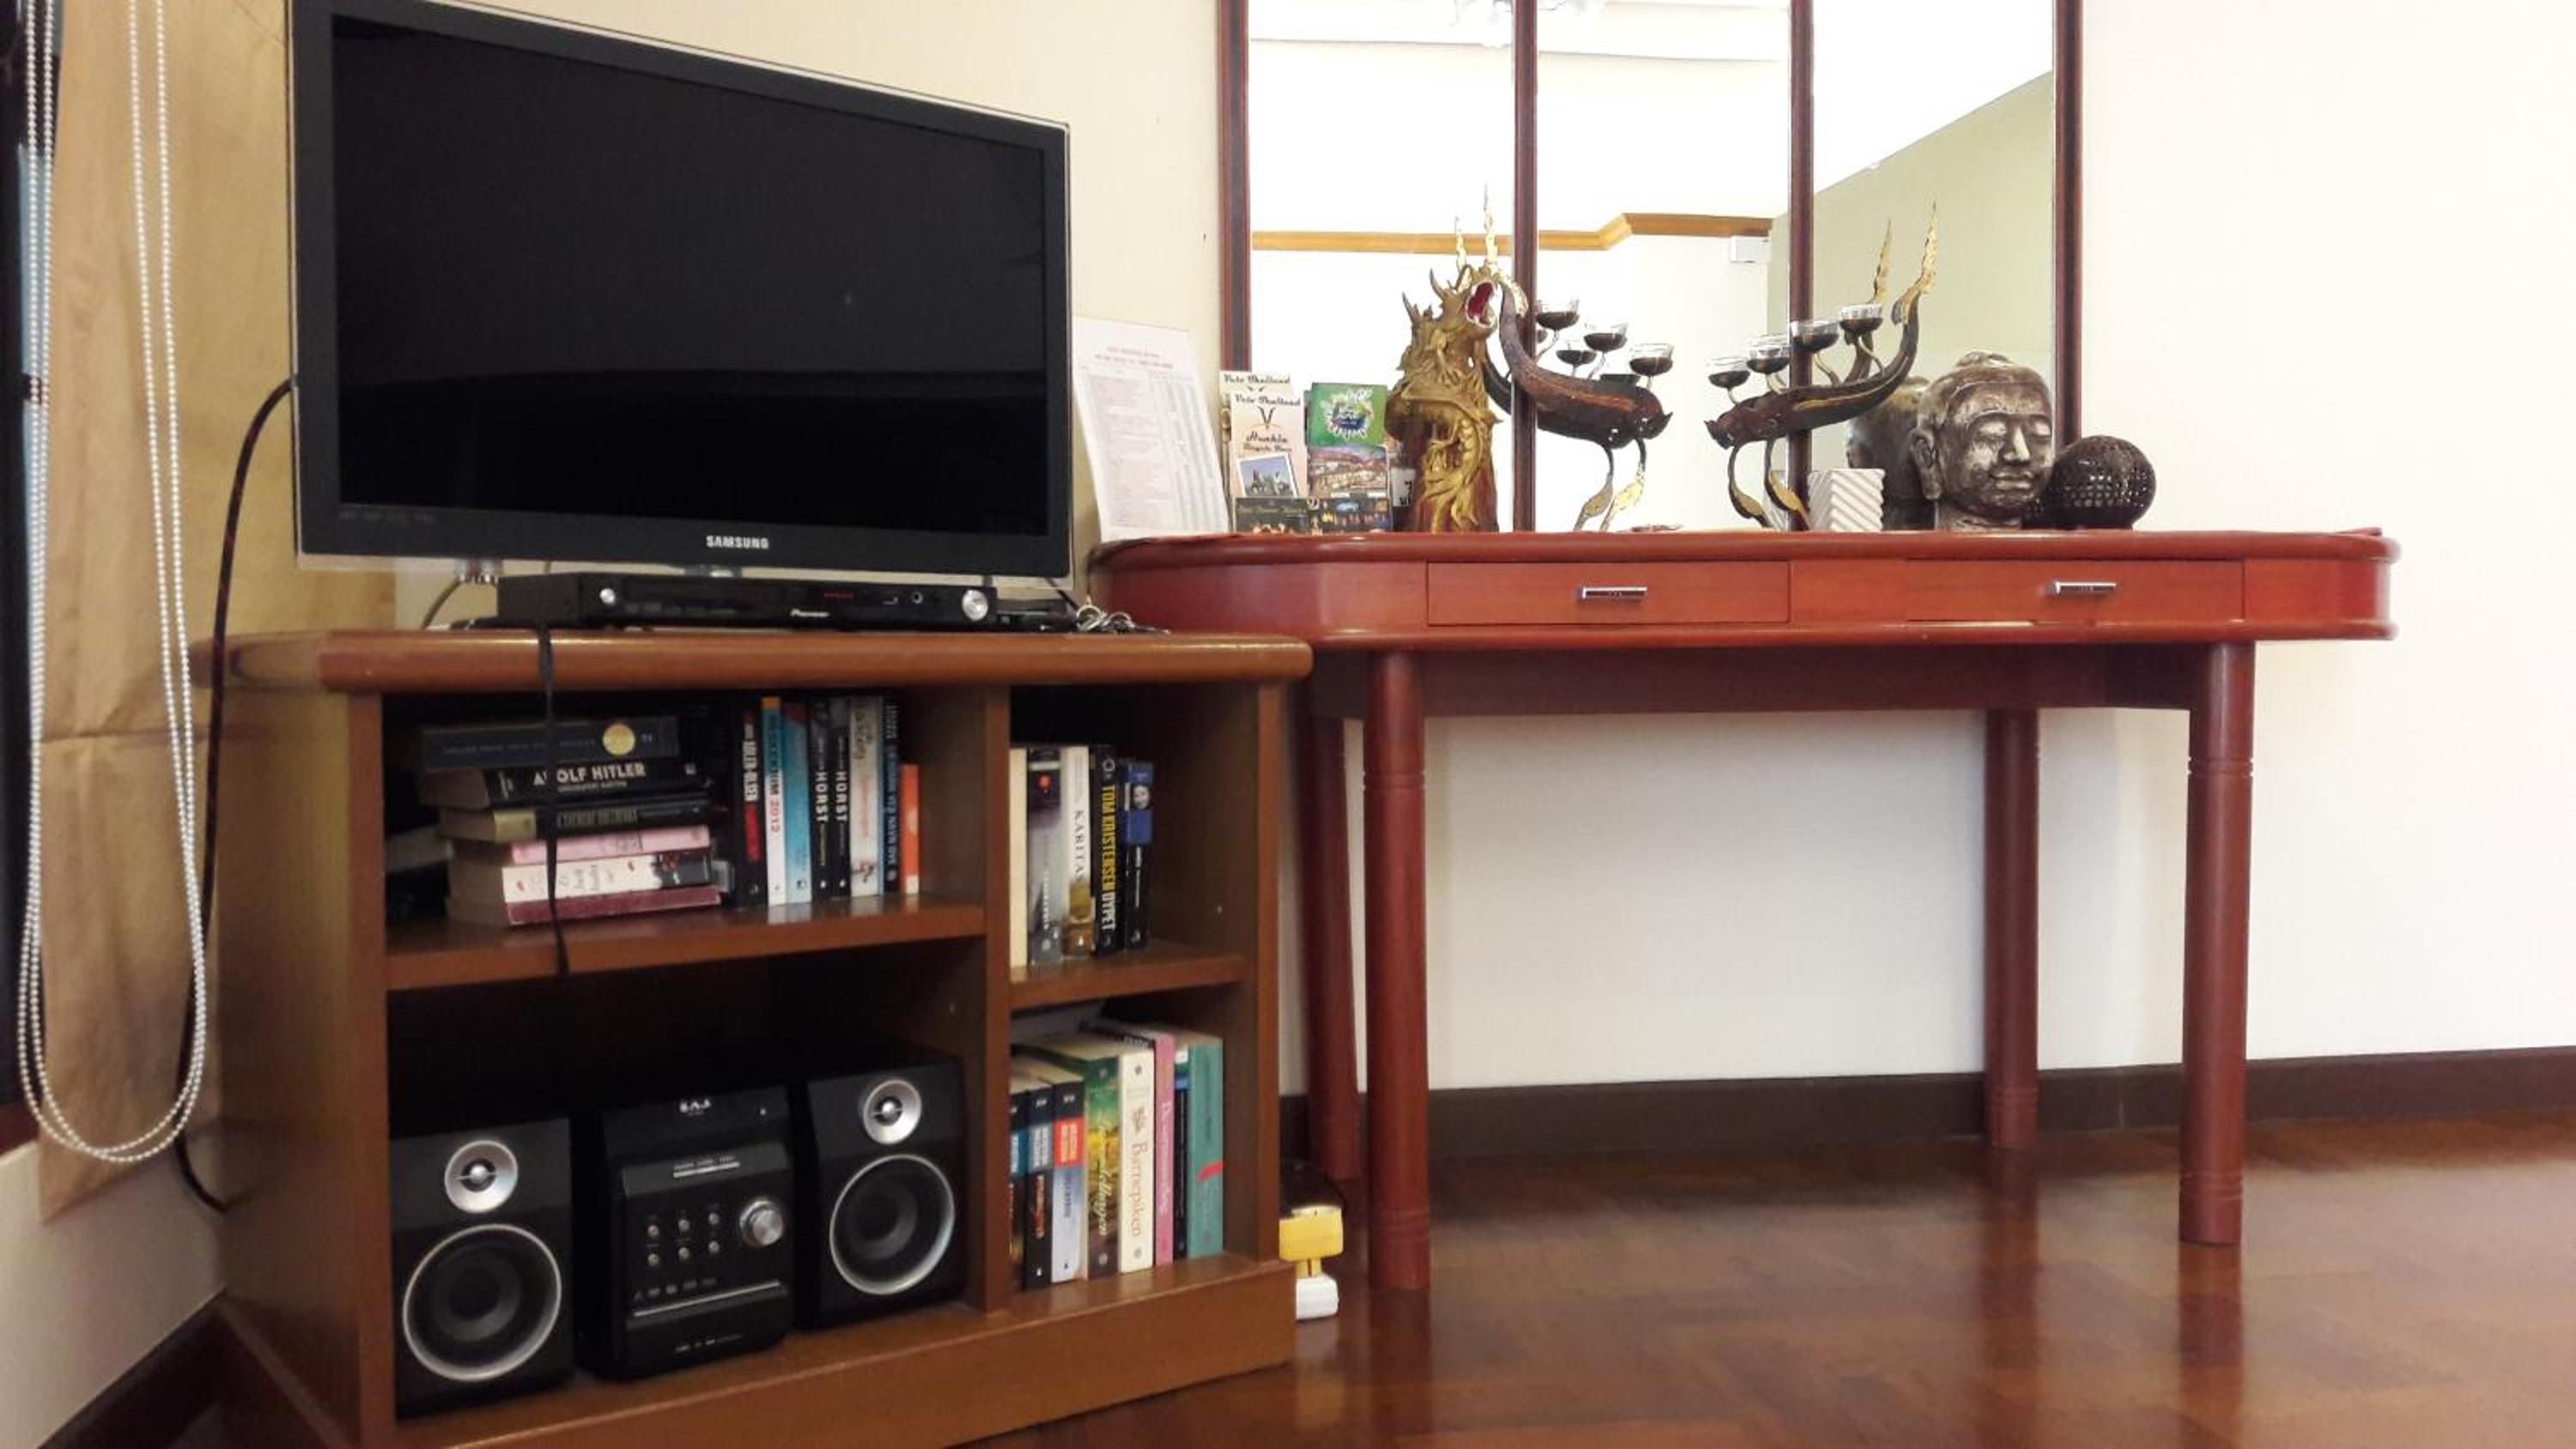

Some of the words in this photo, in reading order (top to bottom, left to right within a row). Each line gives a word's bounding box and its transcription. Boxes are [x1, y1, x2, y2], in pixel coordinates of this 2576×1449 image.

[706, 535, 769, 550] SAMSUNG
[533, 767, 586, 785] AOLF
[592, 762, 647, 780] HITLER
[816, 770, 828, 823] HORST
[835, 770, 848, 822] HORST
[1102, 785, 1115, 814] TOM
[769, 799, 781, 834] 2012
[1074, 810, 1085, 882] KARITAS
[1102, 893, 1116, 931] DYPET
